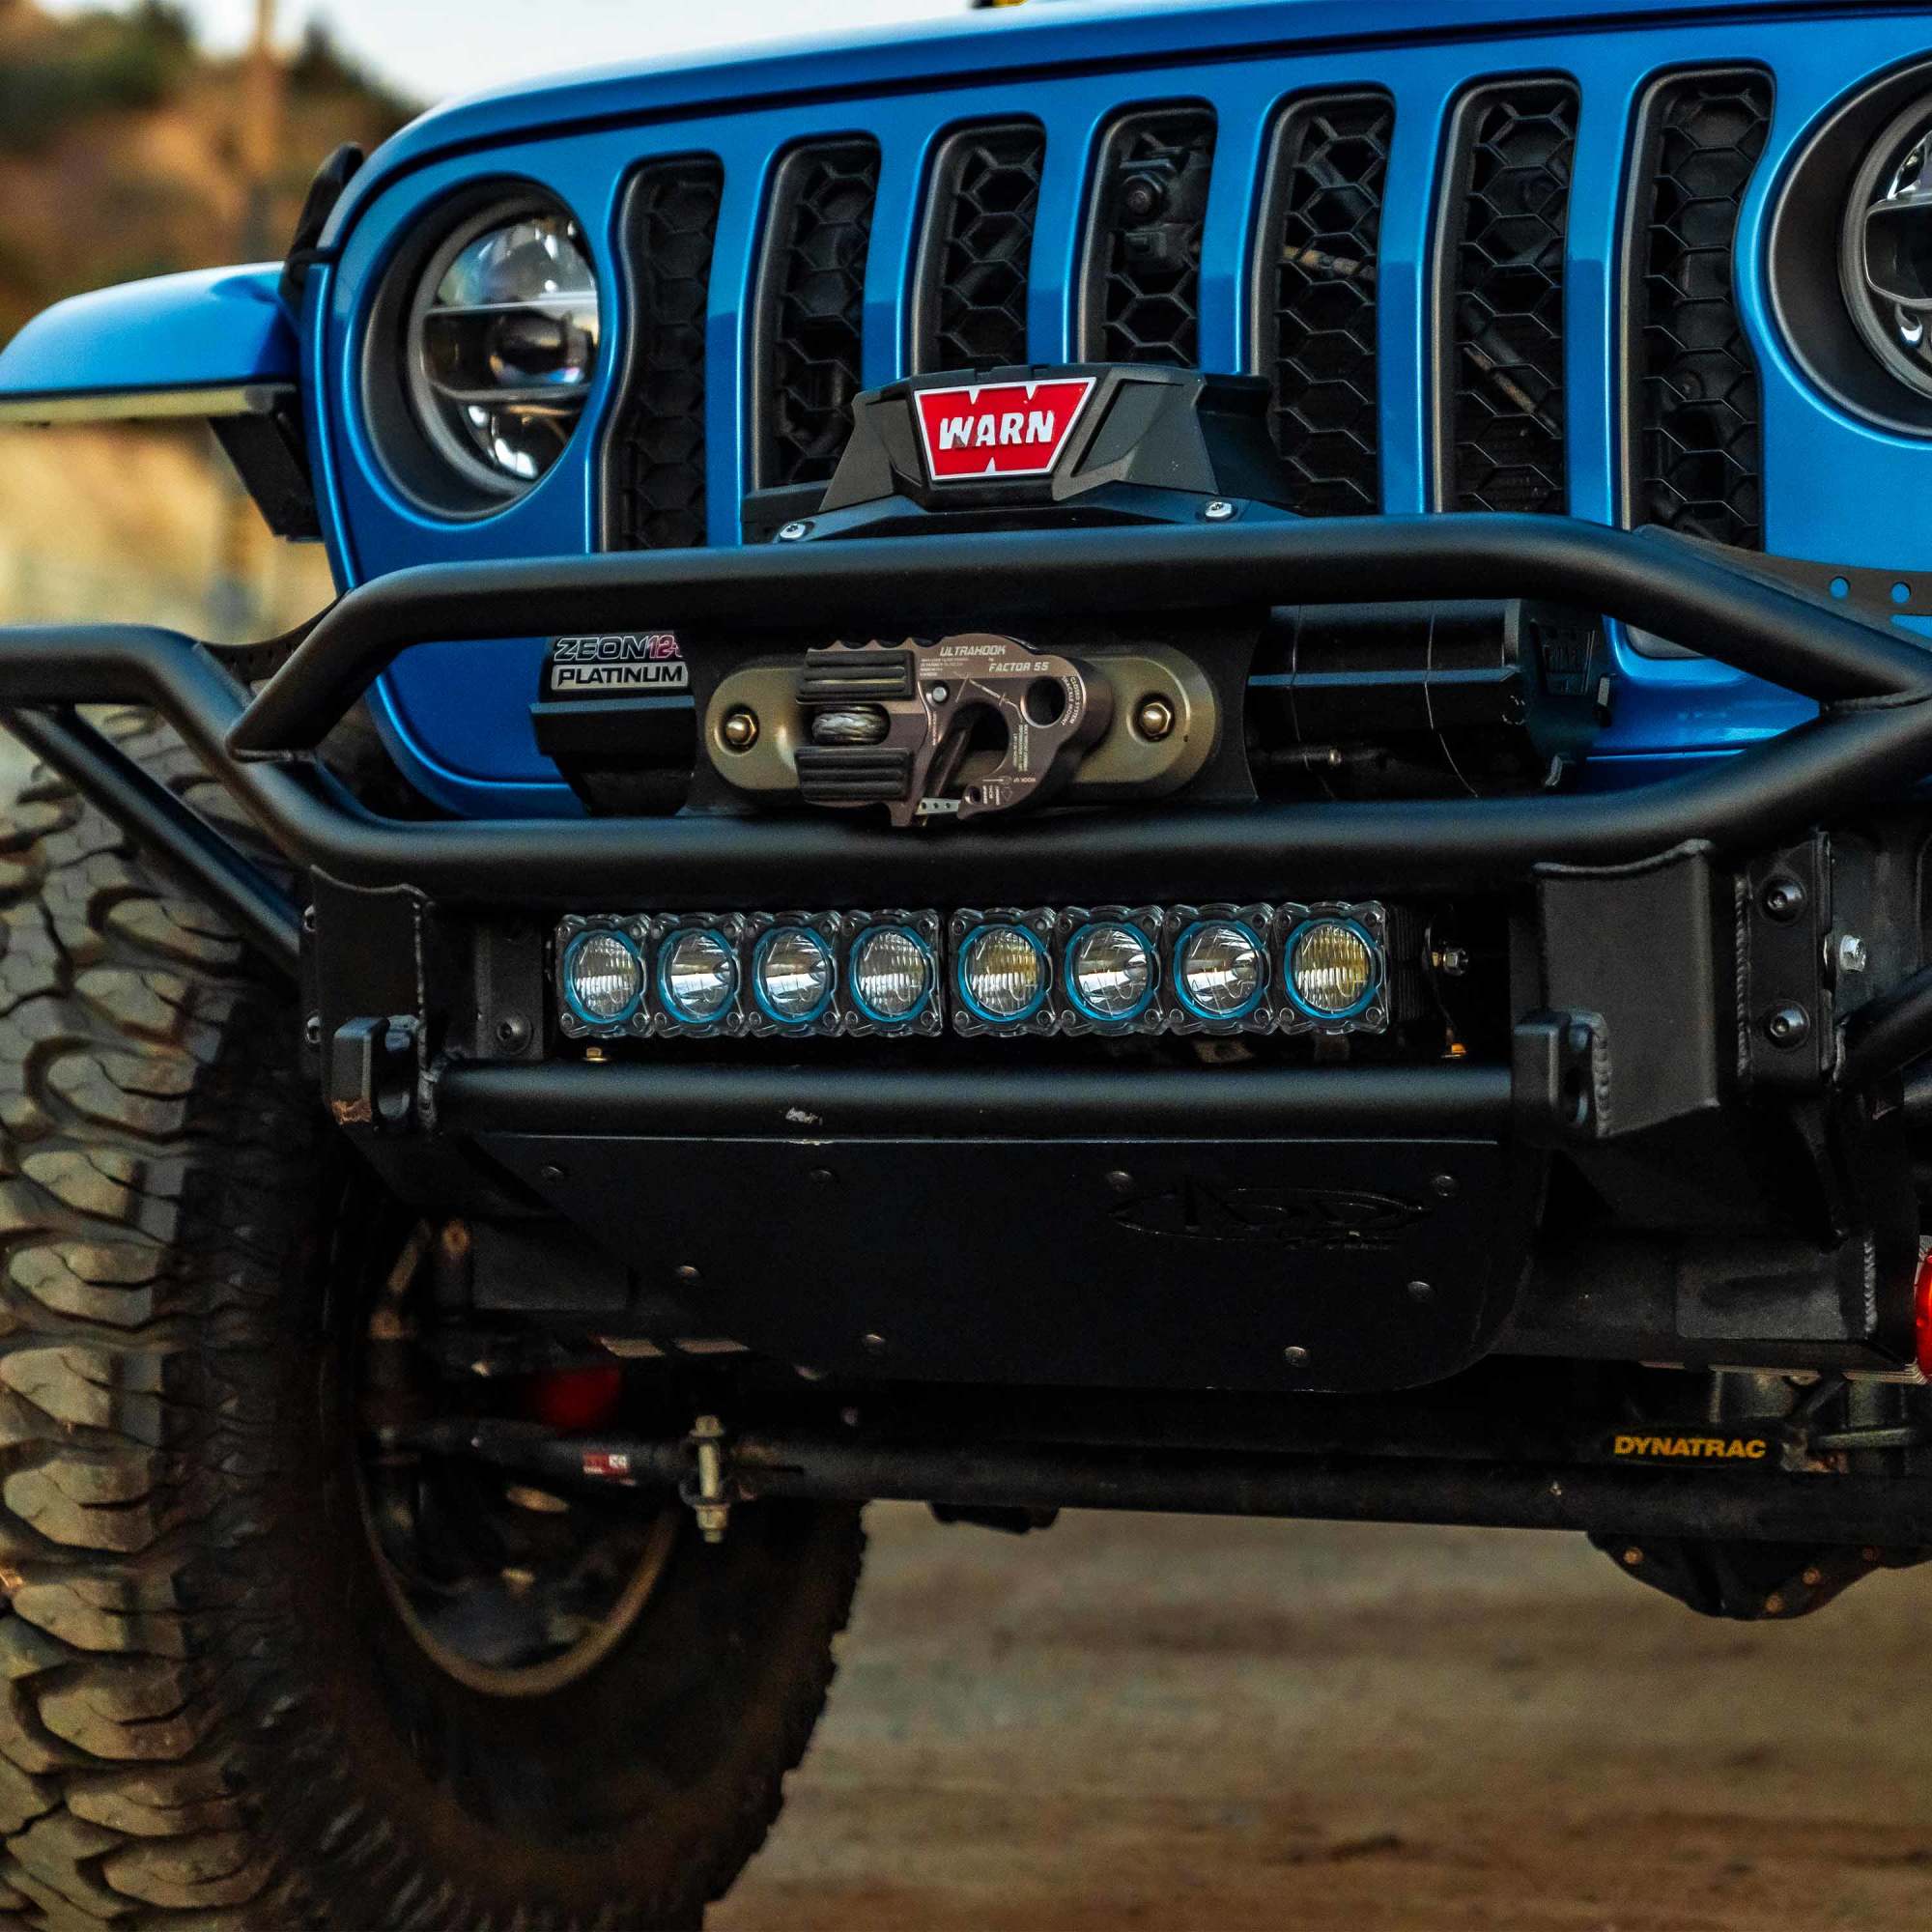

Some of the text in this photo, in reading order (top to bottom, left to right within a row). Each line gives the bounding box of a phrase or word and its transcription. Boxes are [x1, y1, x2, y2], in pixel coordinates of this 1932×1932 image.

[939, 410, 1055, 450] WARN
[940, 644, 1006, 657] ULTRAHOOK
[557, 666, 682, 688] PLATINUM
[988, 662, 1031, 673] FACTOR
[1614, 1435, 1767, 1459] DYNATRAC
